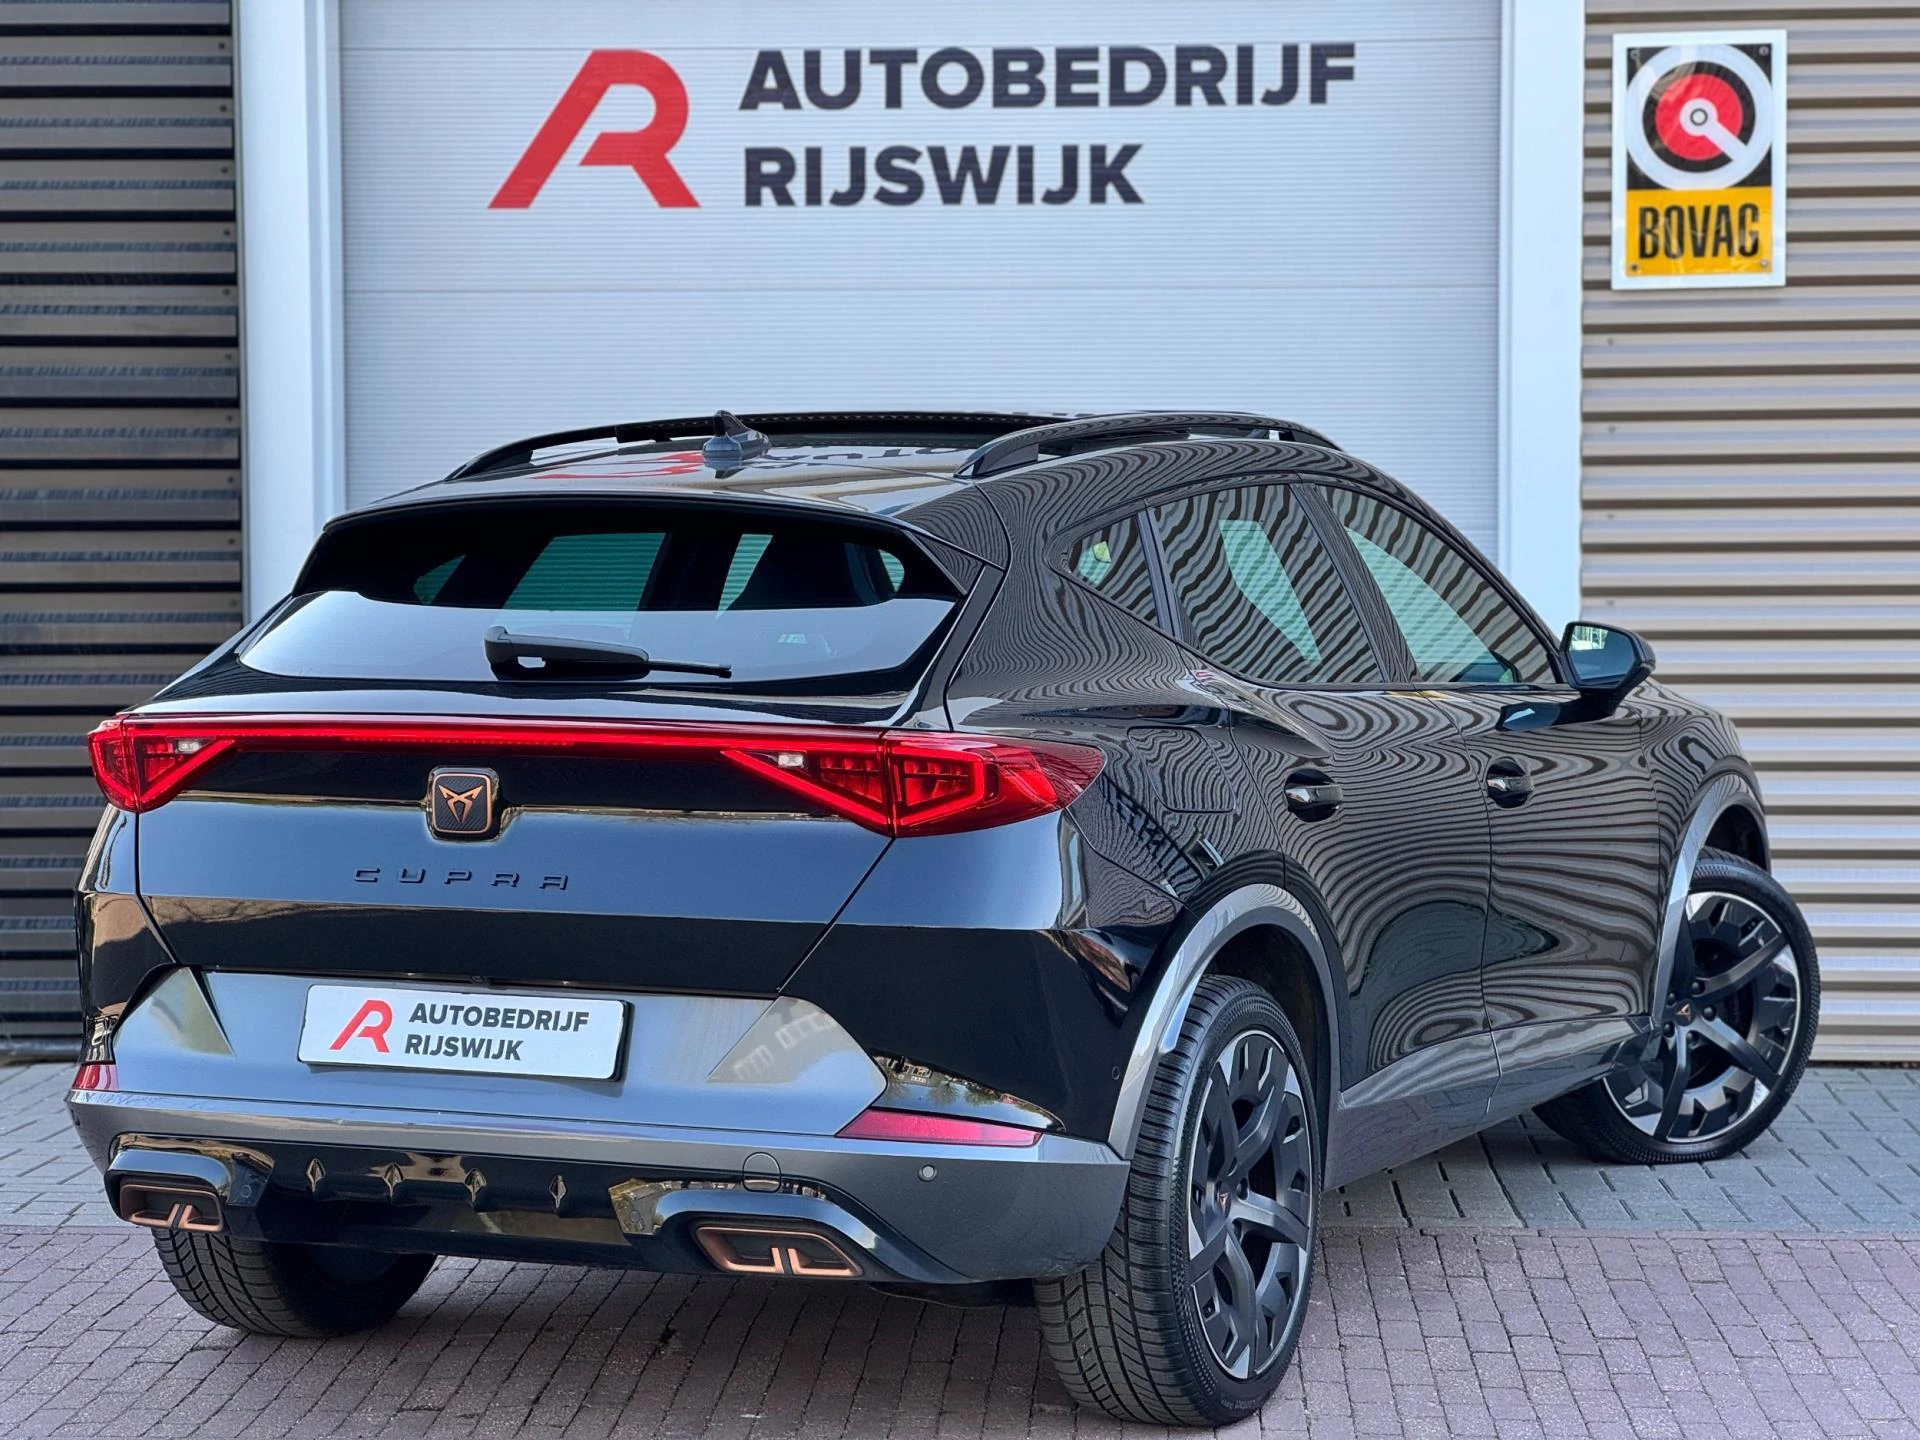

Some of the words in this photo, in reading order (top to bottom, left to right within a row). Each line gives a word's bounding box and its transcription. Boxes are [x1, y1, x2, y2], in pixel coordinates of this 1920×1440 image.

[739, 44, 1356, 111] AUTOBEDRIJF
[744, 145, 1145, 207] RIJSWIJK
[1639, 203, 1760, 259] BOVAG
[354, 867, 569, 890] CUPRA
[409, 1003, 590, 1032] AUTOBEDRIJF
[404, 1035, 524, 1060] RIJSWIJK
